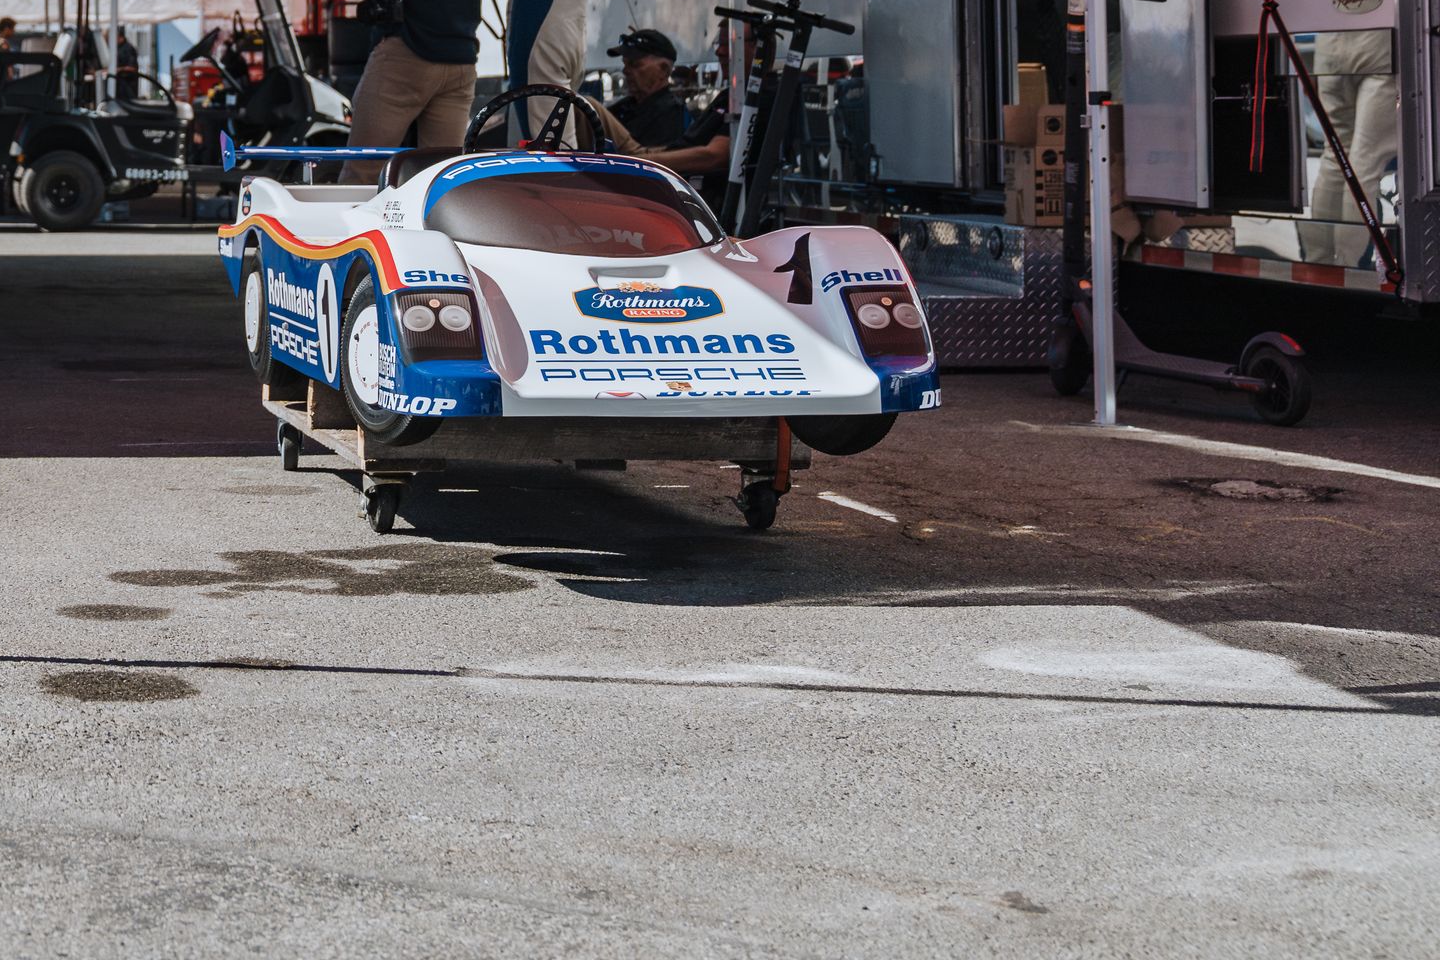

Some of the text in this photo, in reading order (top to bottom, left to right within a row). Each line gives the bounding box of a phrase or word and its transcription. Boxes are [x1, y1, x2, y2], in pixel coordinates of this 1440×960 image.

[773, 232, 813, 305] 1
[821, 268, 904, 293] Shell
[267, 268, 315, 320] Rothmans
[591, 292, 711, 309] Rothmans
[629, 309, 681, 317] RACING
[322, 280, 332, 373] 1
[270, 324, 318, 366] PORSCHE
[529, 329, 796, 355] Rothmans
[540, 367, 807, 382] PORSCHE
[378, 390, 457, 415] DUNLOP
